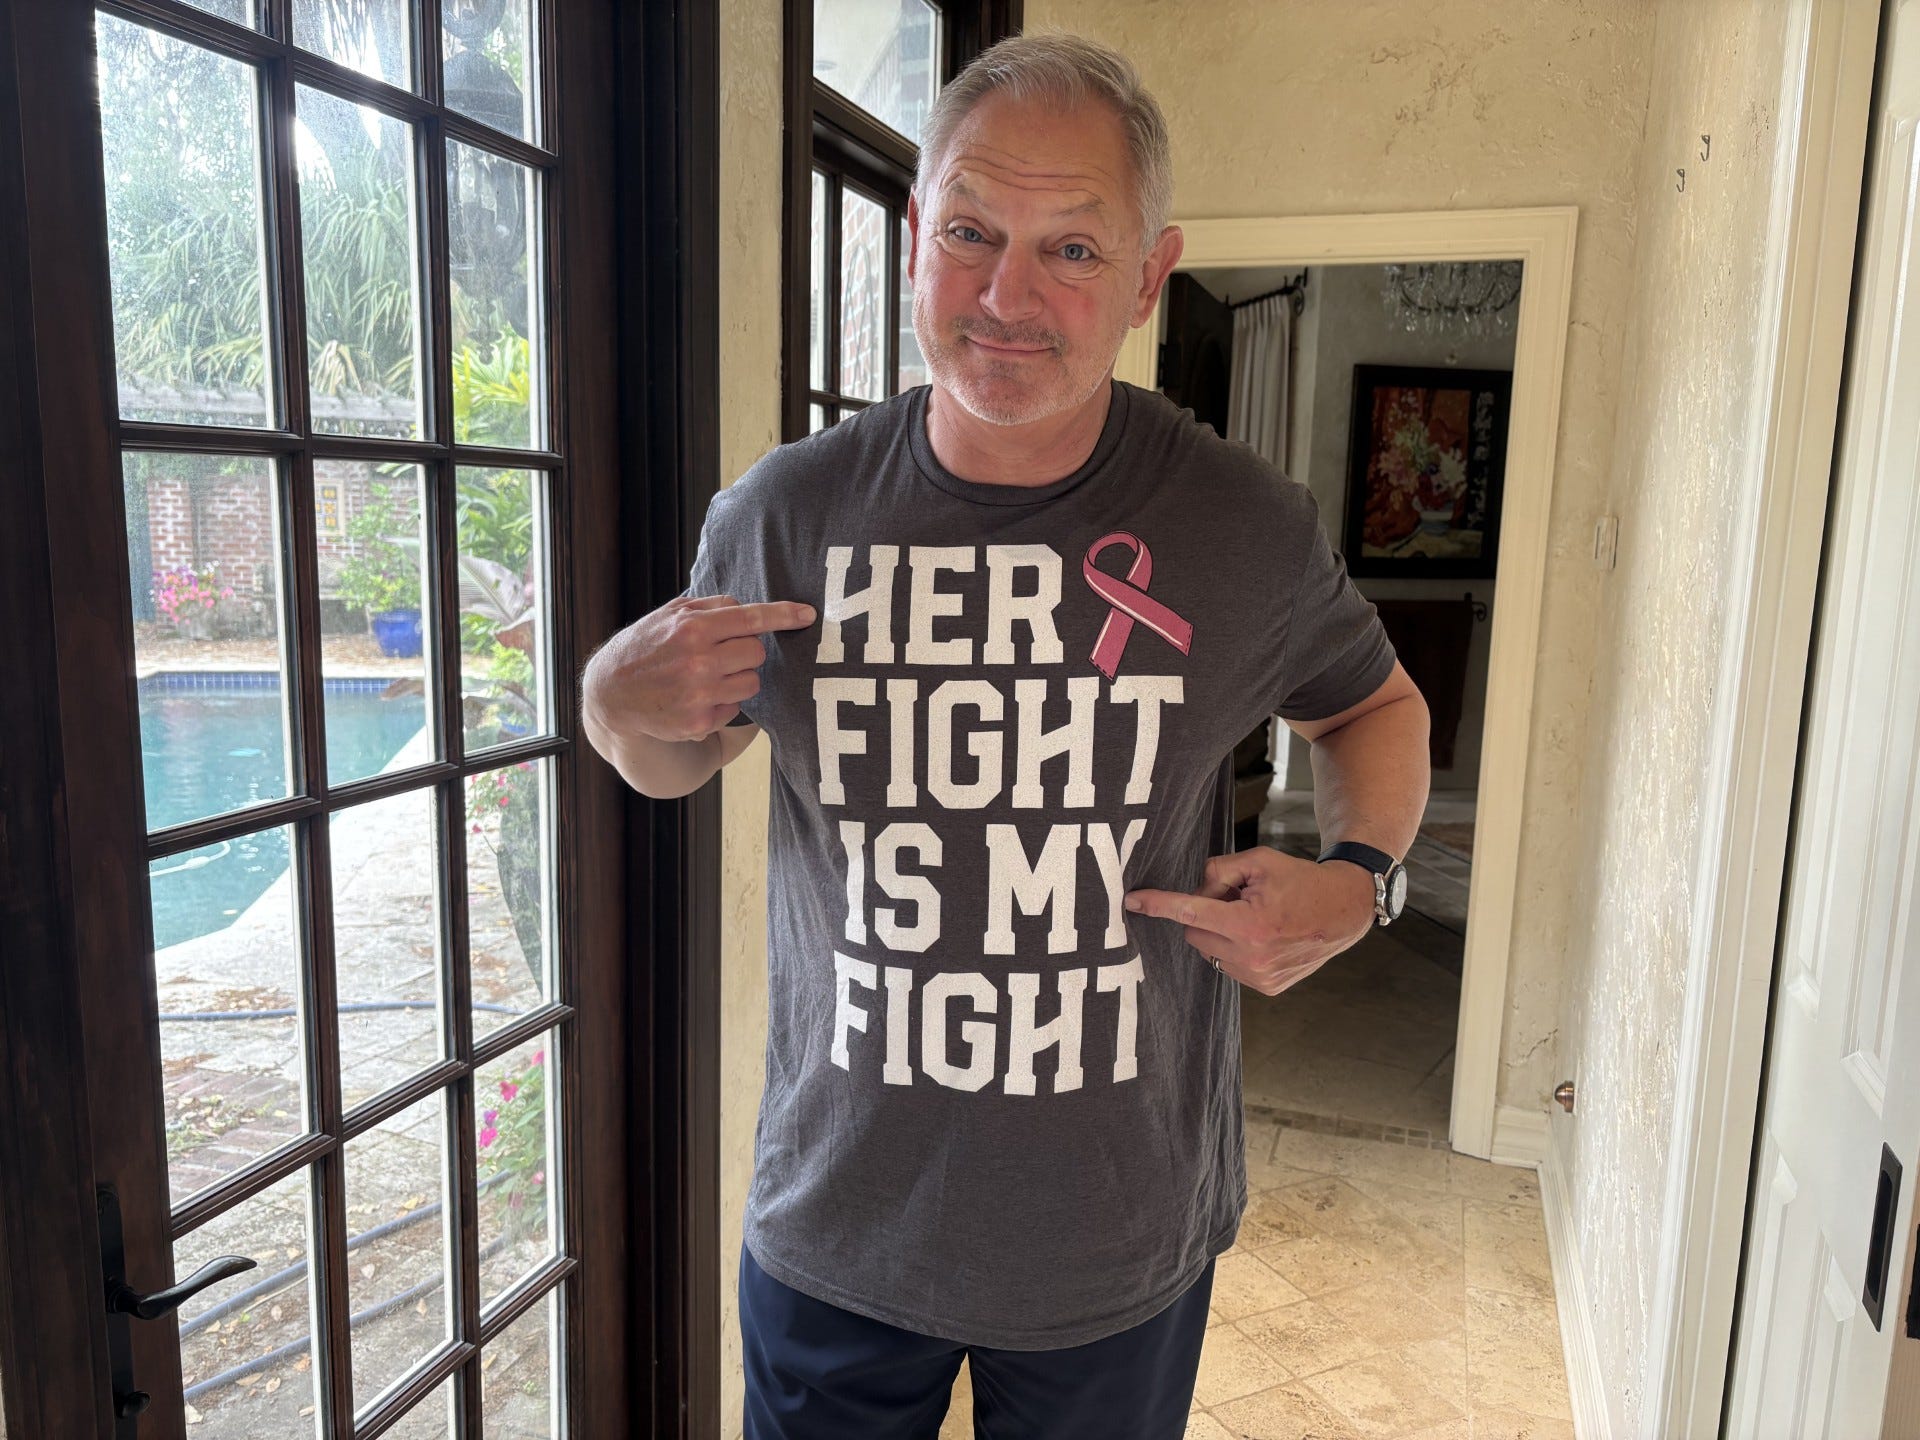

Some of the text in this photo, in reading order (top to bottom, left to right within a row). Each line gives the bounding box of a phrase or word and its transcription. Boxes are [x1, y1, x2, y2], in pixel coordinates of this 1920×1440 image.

[816, 544, 1064, 664] HER
[813, 676, 1185, 810] FIGHT
[839, 819, 1148, 955] IS MY
[831, 950, 1145, 1096] FIGHT
